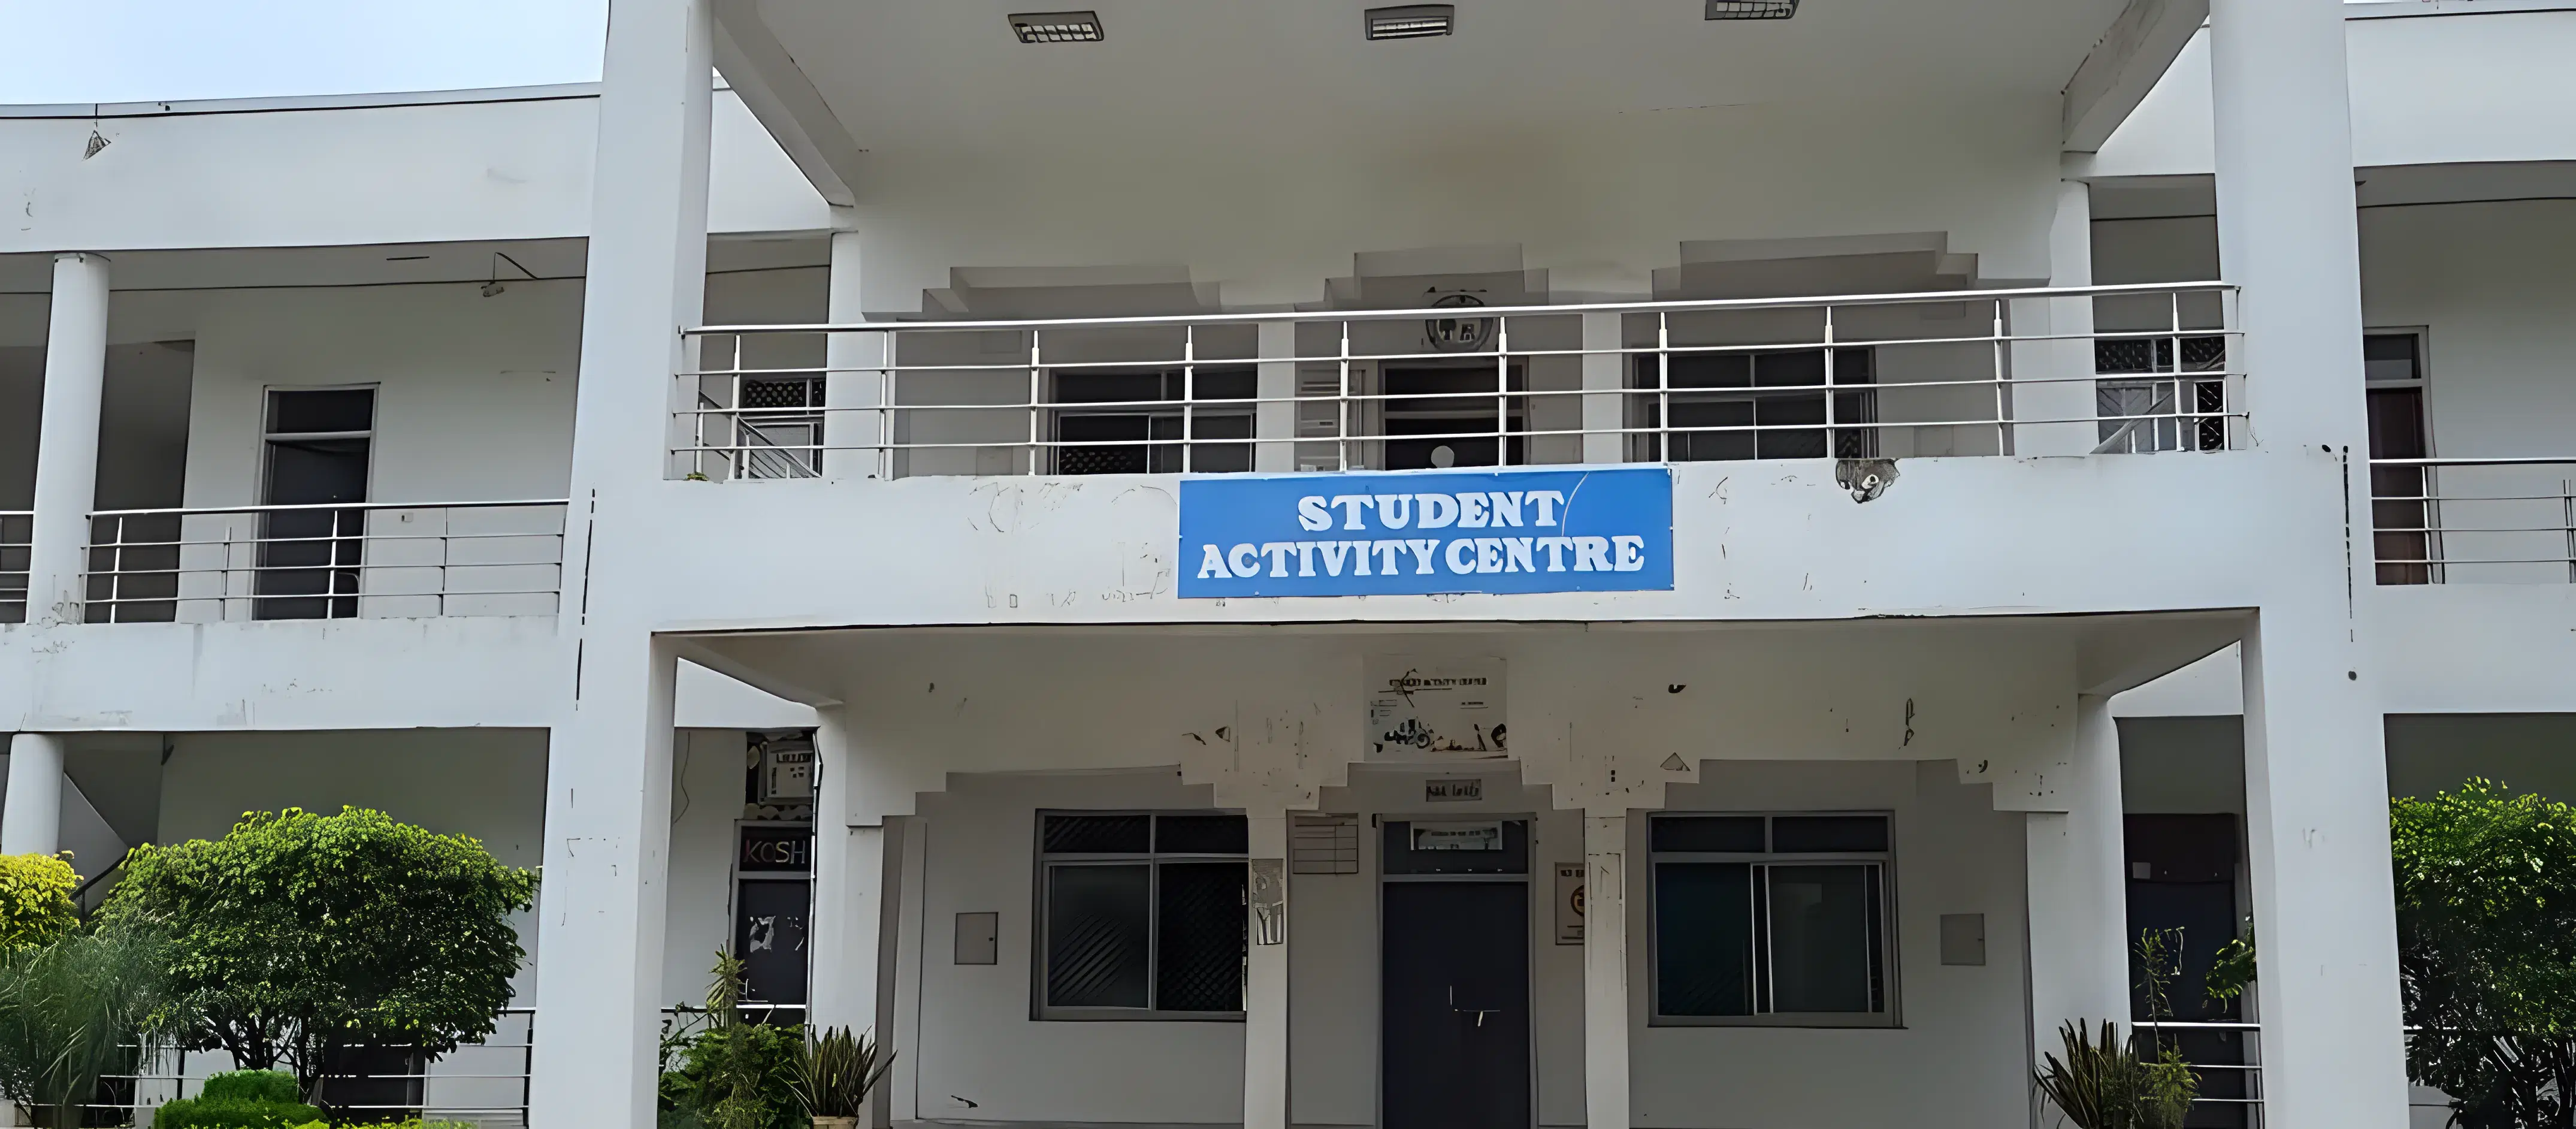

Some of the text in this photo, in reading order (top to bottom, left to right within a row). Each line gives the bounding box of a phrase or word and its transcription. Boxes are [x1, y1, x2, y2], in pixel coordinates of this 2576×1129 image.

[1298, 490, 1565, 532] STUDENT
[1198, 535, 1644, 578] ACTIVITY CENTRE
